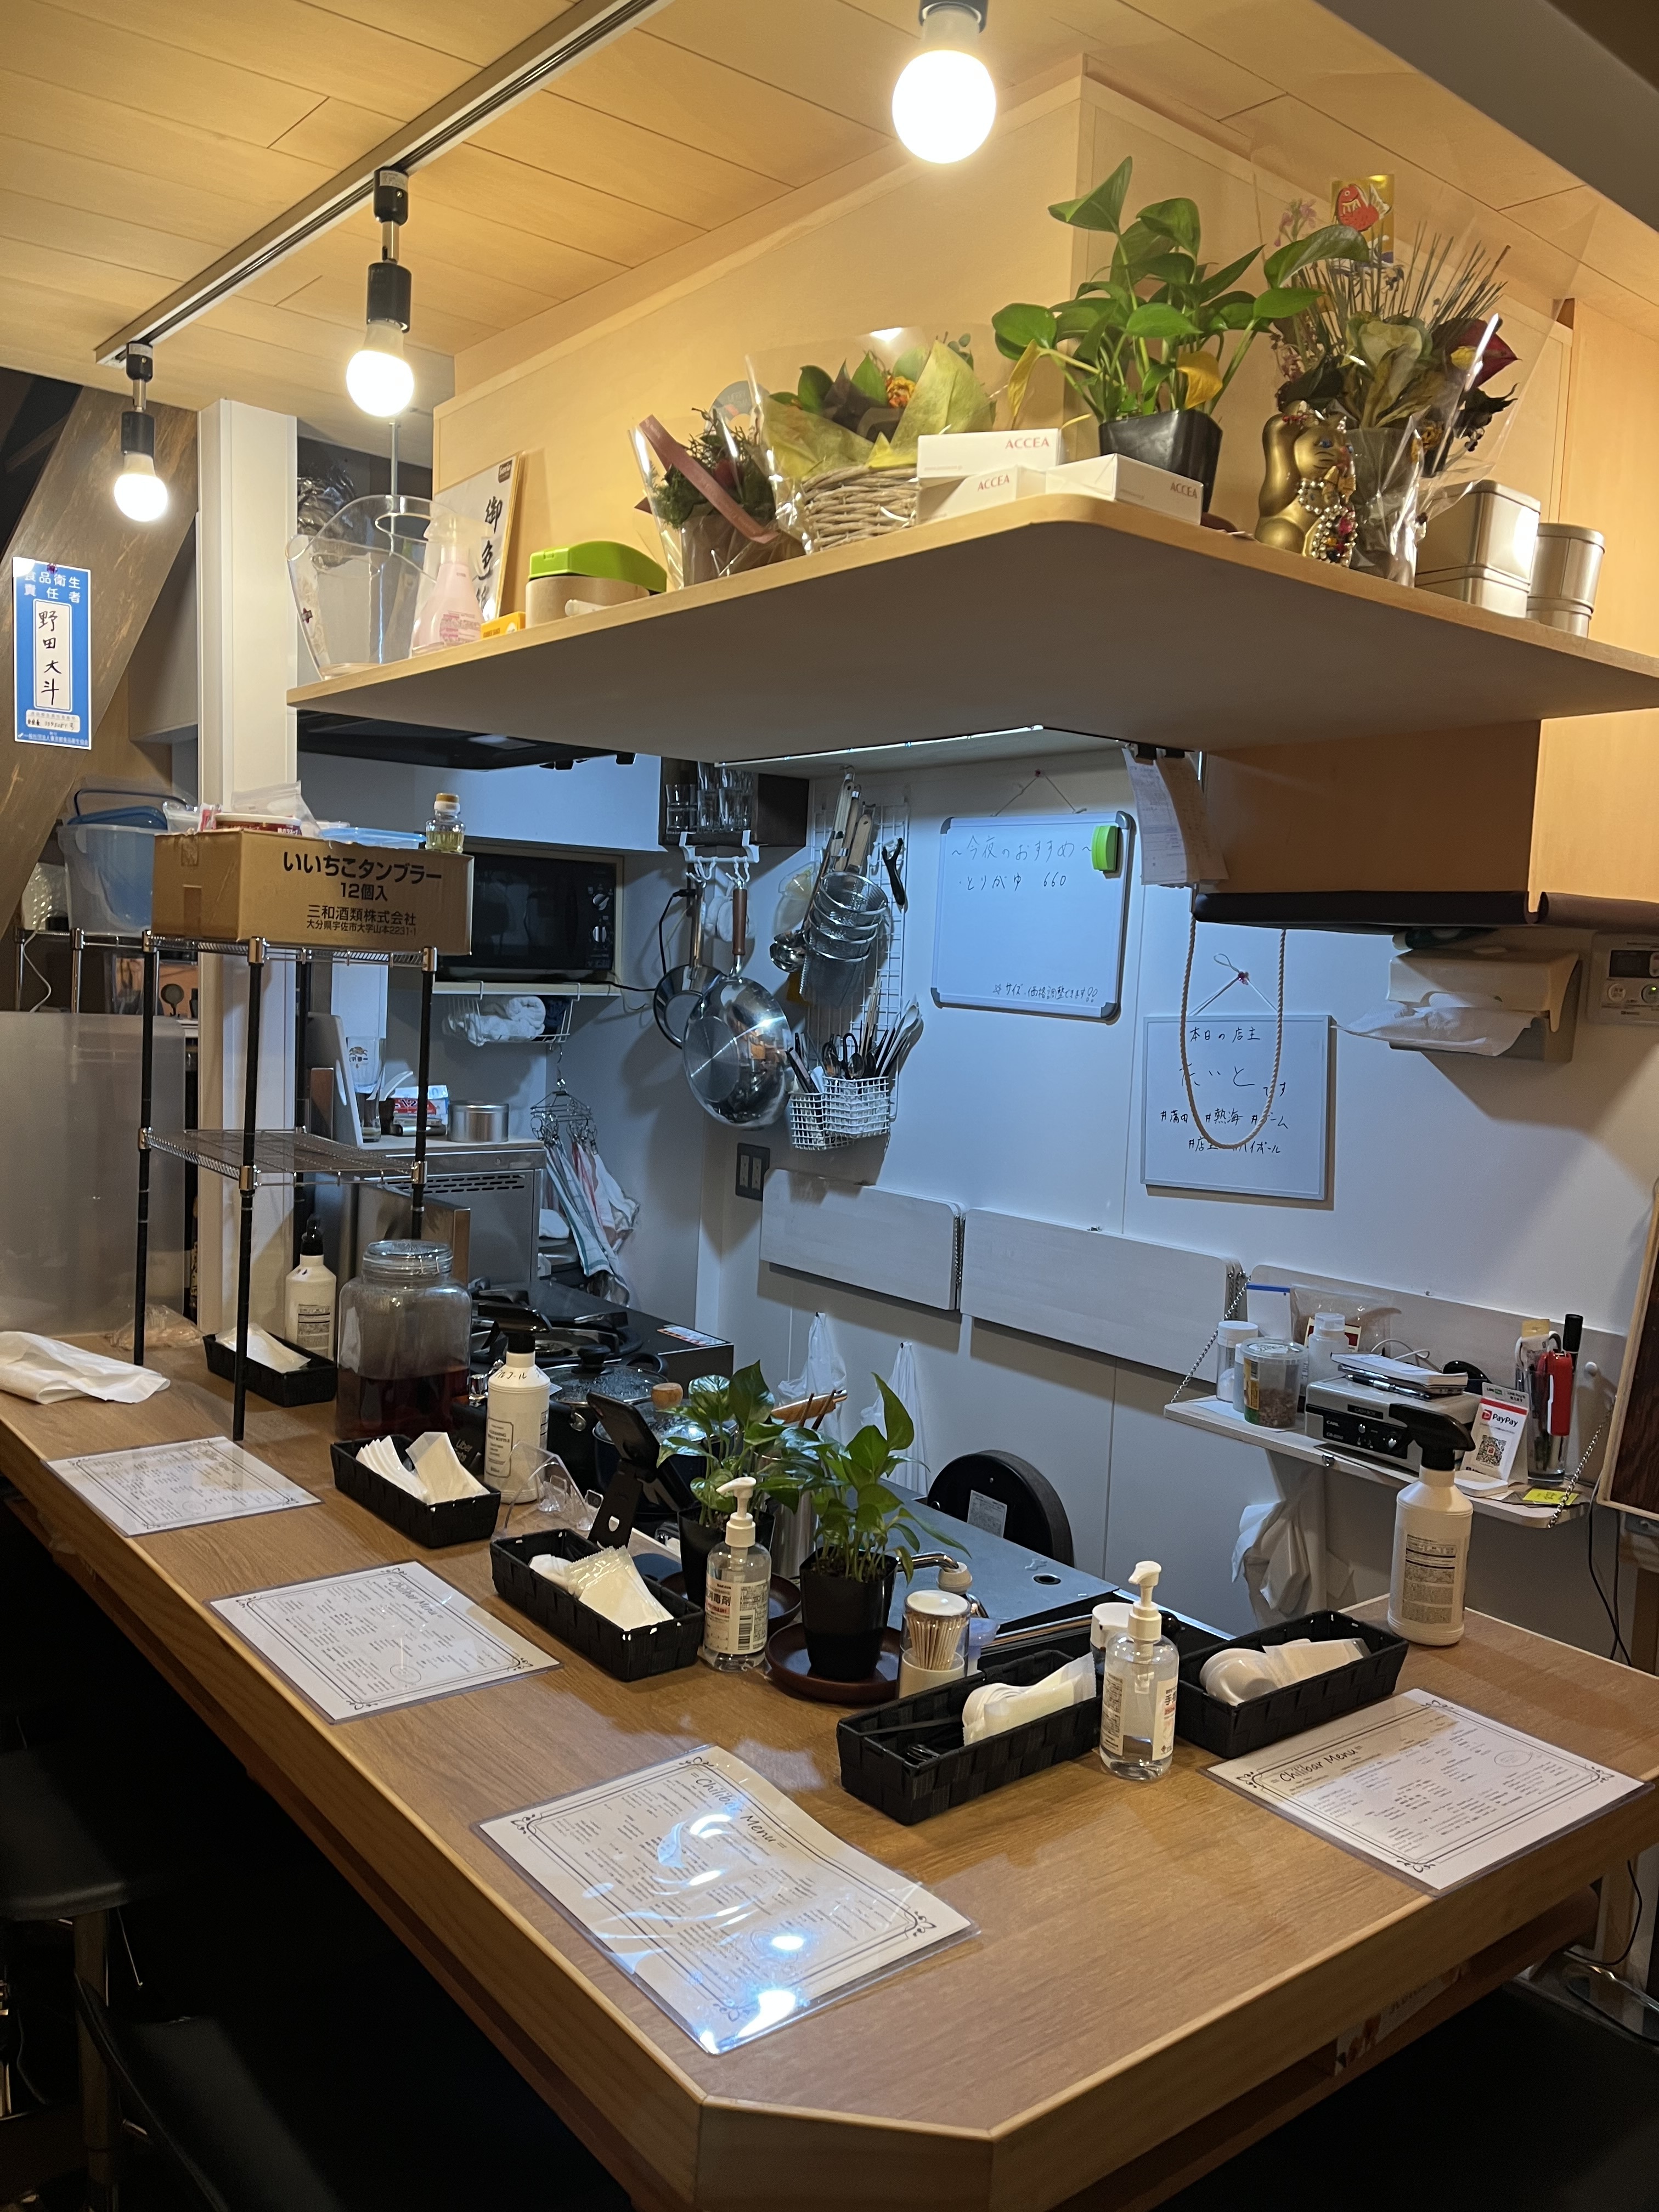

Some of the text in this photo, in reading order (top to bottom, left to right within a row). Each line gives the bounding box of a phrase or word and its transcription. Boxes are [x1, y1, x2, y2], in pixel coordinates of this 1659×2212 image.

[1006, 437, 1049, 449] ACCEA
[978, 474, 1010, 492] ACCEA
[1170, 482, 1198, 499] ACCEA
[23, 571, 81, 589] 食品衛生
[37, 610, 62, 706] 野田大斗
[283, 851, 442, 884] いいちこタンブラー
[1043, 872, 1066, 888] 660
[340, 882, 388, 901] 12個入
[307, 904, 416, 926] 三和酒類株式会社
[1189, 1026, 1261, 1043] 本日の店主
[1205, 1108, 1244, 1127] #熱海
[1251, 1112, 1289, 1130] #ーム
[1492, 1413, 1519, 1427] PayPay
[456, 1438, 473, 1452] Uber
